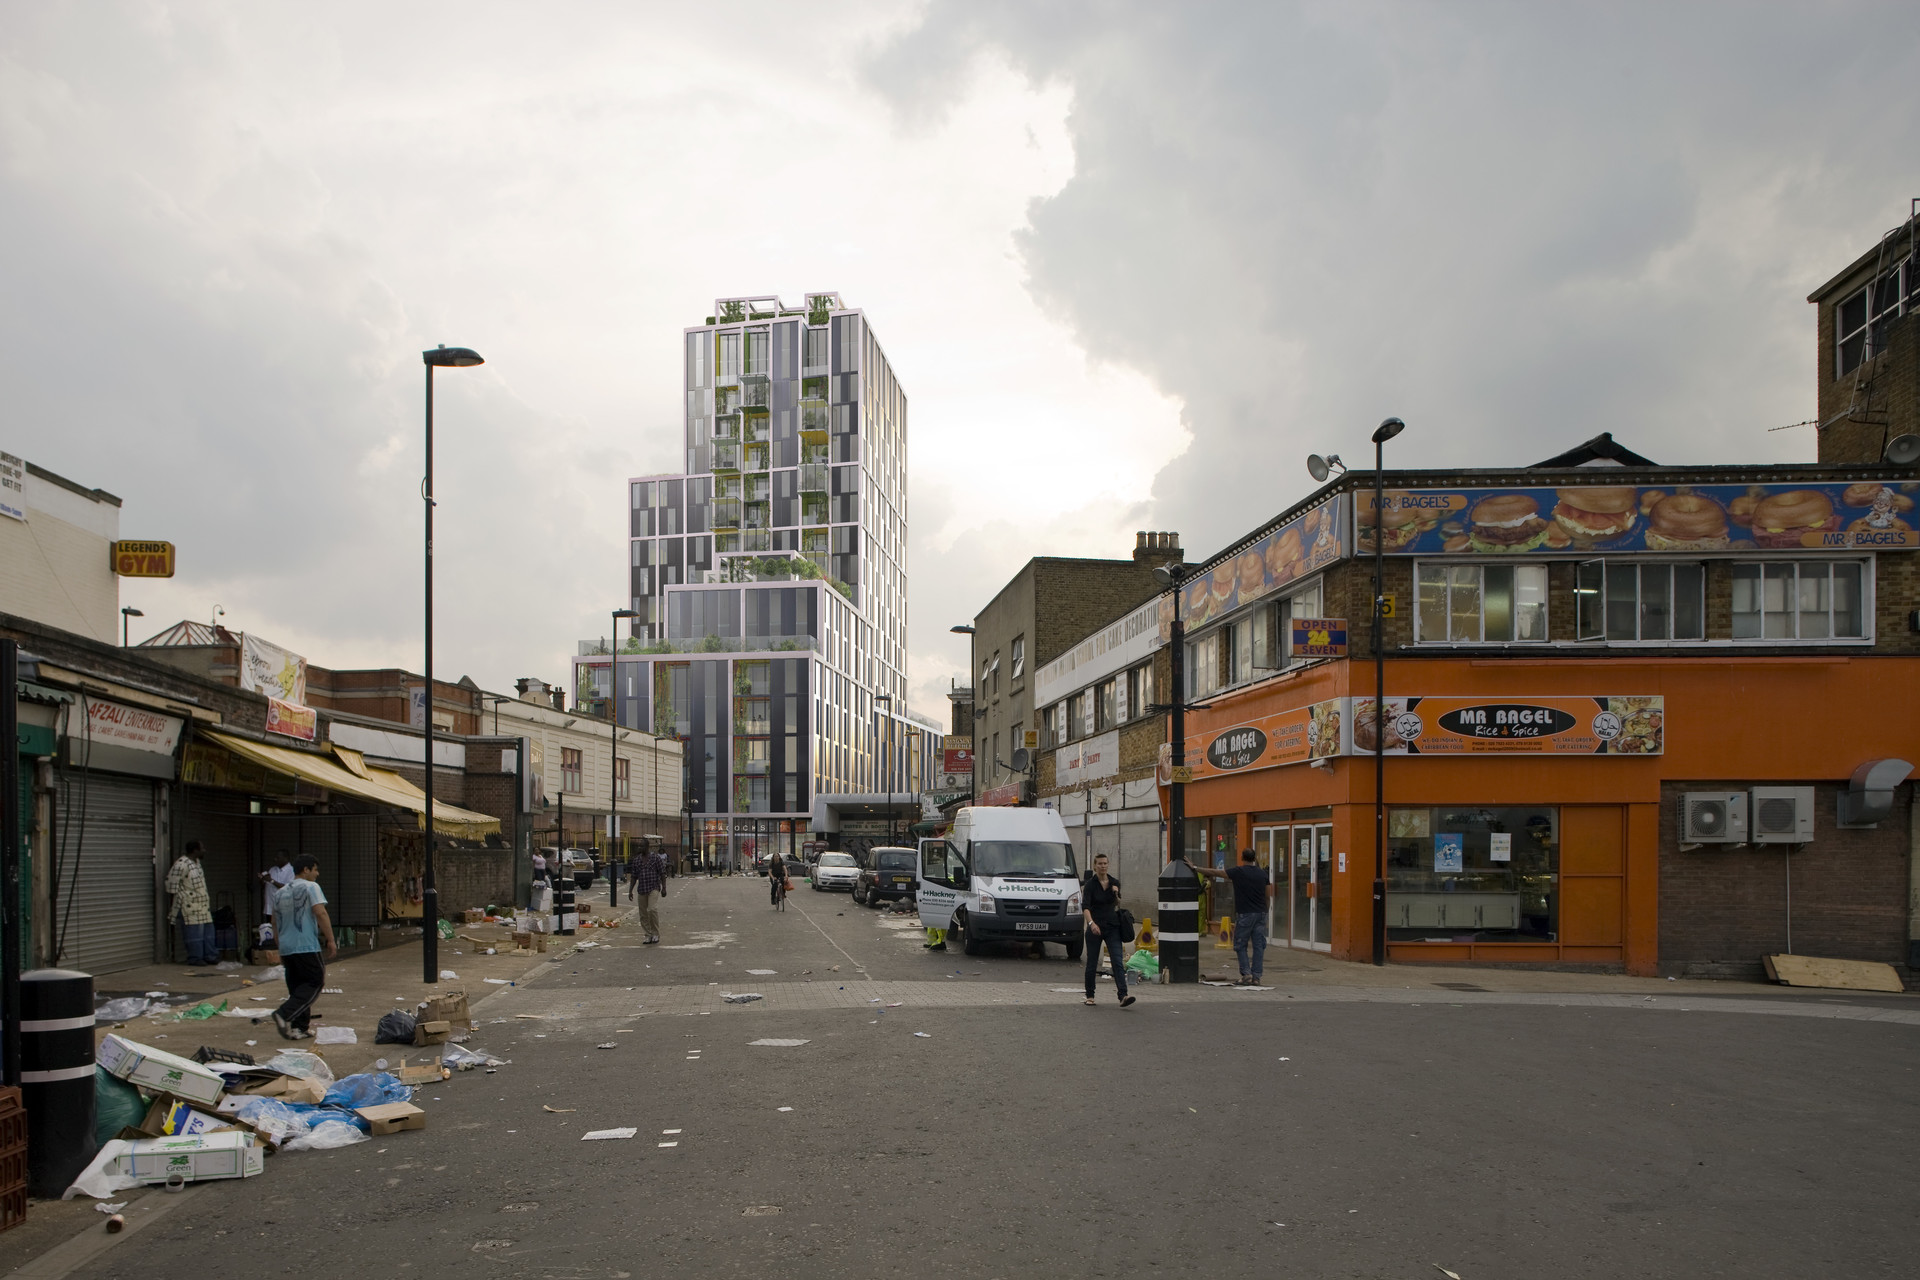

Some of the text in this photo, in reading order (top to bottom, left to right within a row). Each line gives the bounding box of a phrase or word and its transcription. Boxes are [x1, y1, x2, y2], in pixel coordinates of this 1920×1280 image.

[2, 478, 13, 489] GET
[1402, 496, 1450, 508] BAGEL'S
[1823, 532, 1906, 545] MR BAGEL'S
[118, 543, 167, 553] LEGENDS
[119, 554, 167, 573] GYM
[1124, 602, 1160, 642] DECORATIN
[1302, 620, 1337, 629] OPEN
[1308, 630, 1331, 646] 24
[1303, 645, 1337, 655] SEVEN
[89, 702, 168, 732] AFZALI ENTERPRISES
[1459, 709, 1553, 724] MR BAGEL
[1475, 725, 1499, 737] Rice
[1511, 723, 1539, 737] Spice
[1215, 731, 1257, 756] MR BAGEL
[1087, 753, 1101, 765] PARTY
[1221, 756, 1232, 768] Rice
[1237, 751, 1251, 765] Spice
[929, 889, 956, 899] Hackney
[1011, 884, 1063, 896] Hackney
[161, 1075, 182, 1087] Green
[165, 1164, 192, 1172] Green
